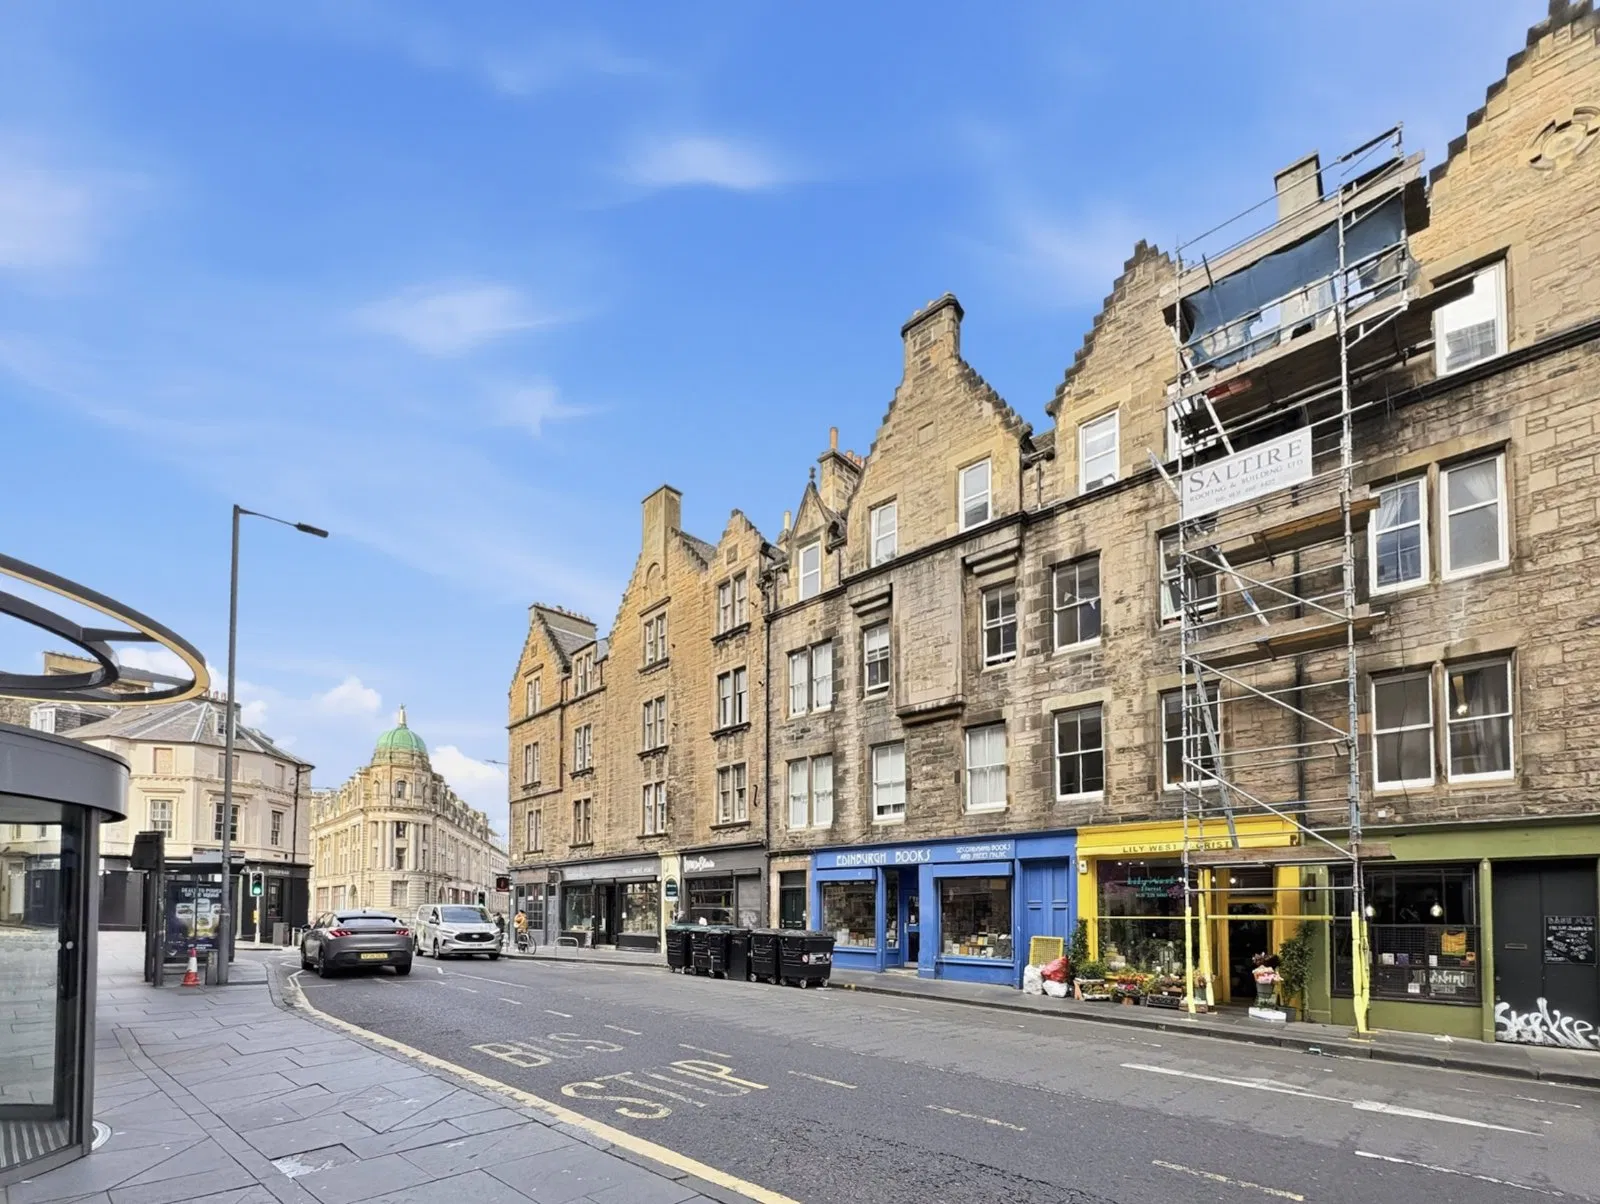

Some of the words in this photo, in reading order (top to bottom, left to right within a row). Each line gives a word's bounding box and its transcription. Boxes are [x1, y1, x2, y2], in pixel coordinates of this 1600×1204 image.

[1189, 439, 1303, 493] SALTIRE
[1241, 465, 1283, 485] BUILDING
[836, 851, 887, 866] EDINBURGH
[895, 848, 931, 863] BOOKS
[1122, 845, 1146, 853] LILY
[1149, 843, 1177, 852] WEST
[1189, 840, 1229, 850] ORIST
[470, 1032, 624, 1068] BUS
[560, 1059, 769, 1119] STOP
